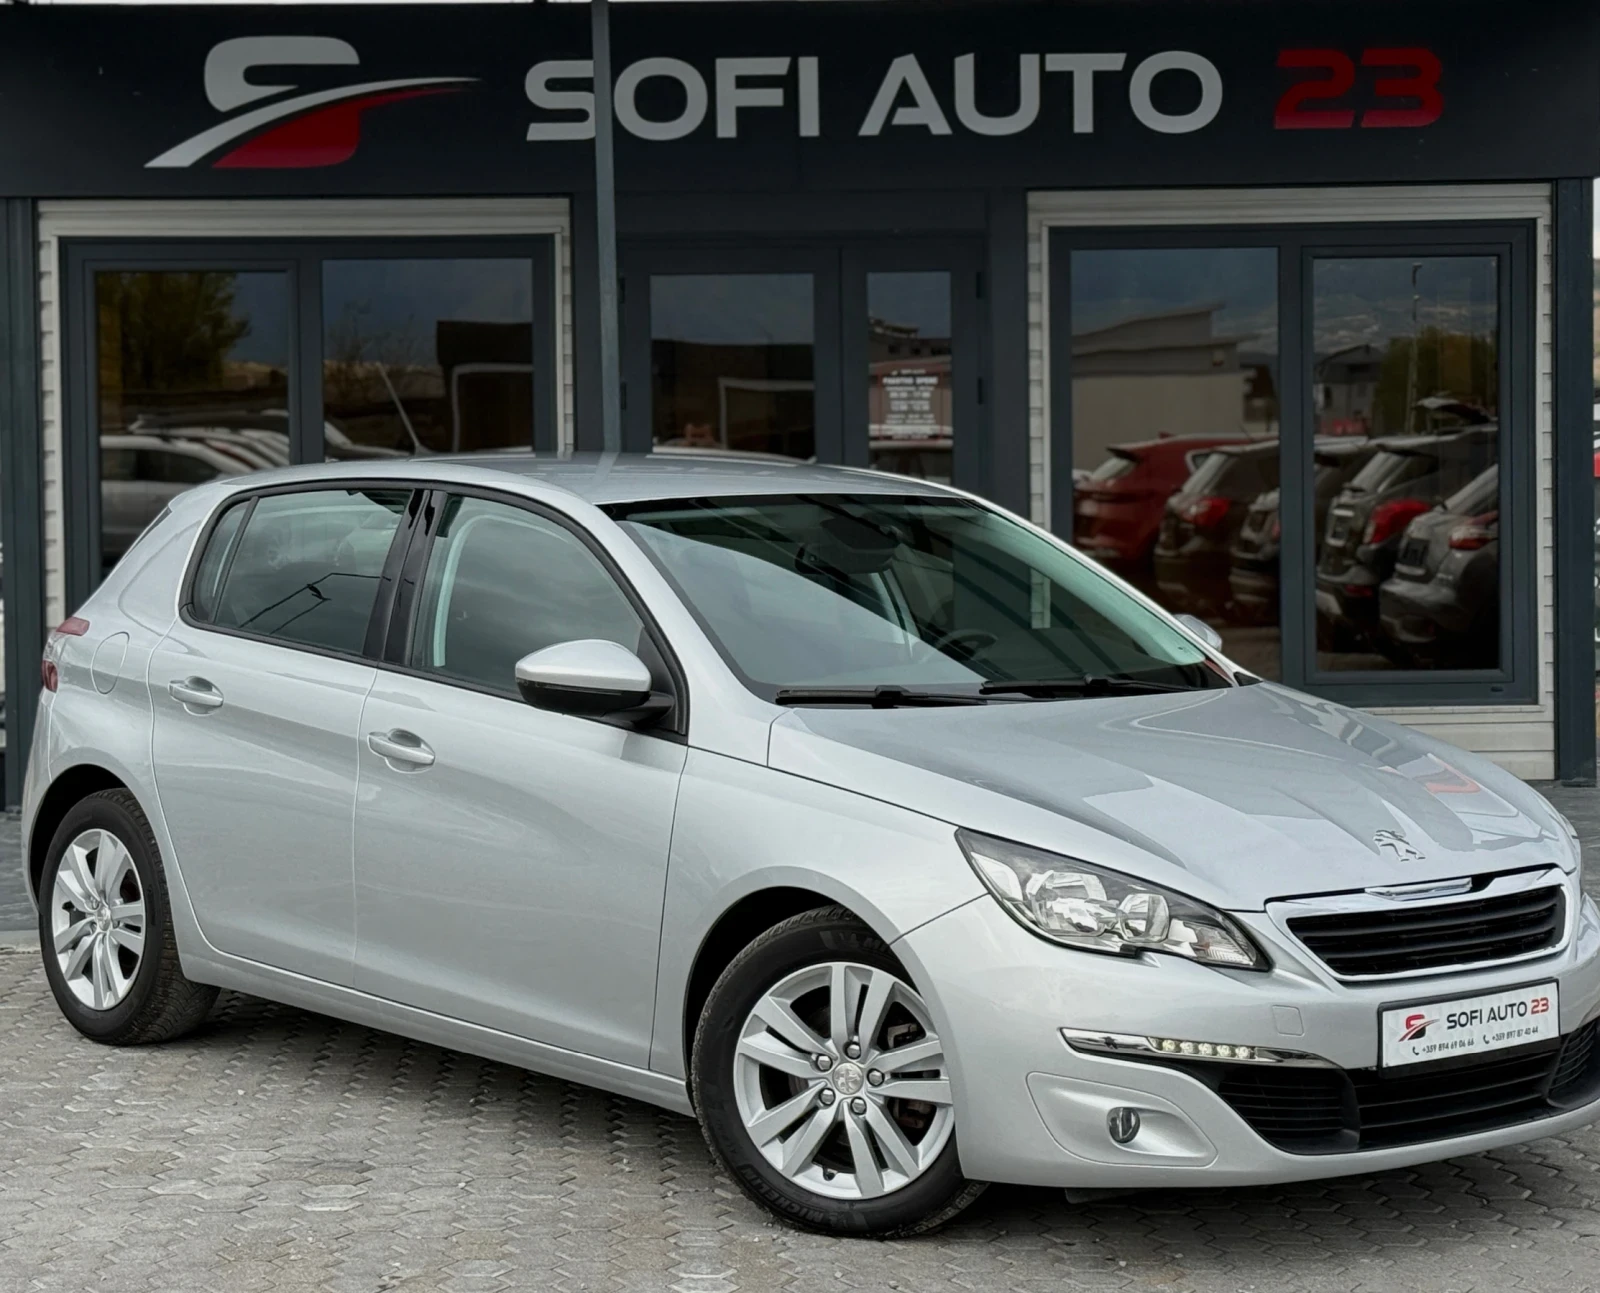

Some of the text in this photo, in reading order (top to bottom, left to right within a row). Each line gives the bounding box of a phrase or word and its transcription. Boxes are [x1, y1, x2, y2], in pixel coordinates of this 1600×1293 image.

[525, 48, 1443, 141] SOFI AUTO 23
[1447, 997, 1549, 1029] SOFI AUTO 23
[739, 1166, 825, 1223] MICHELIN
